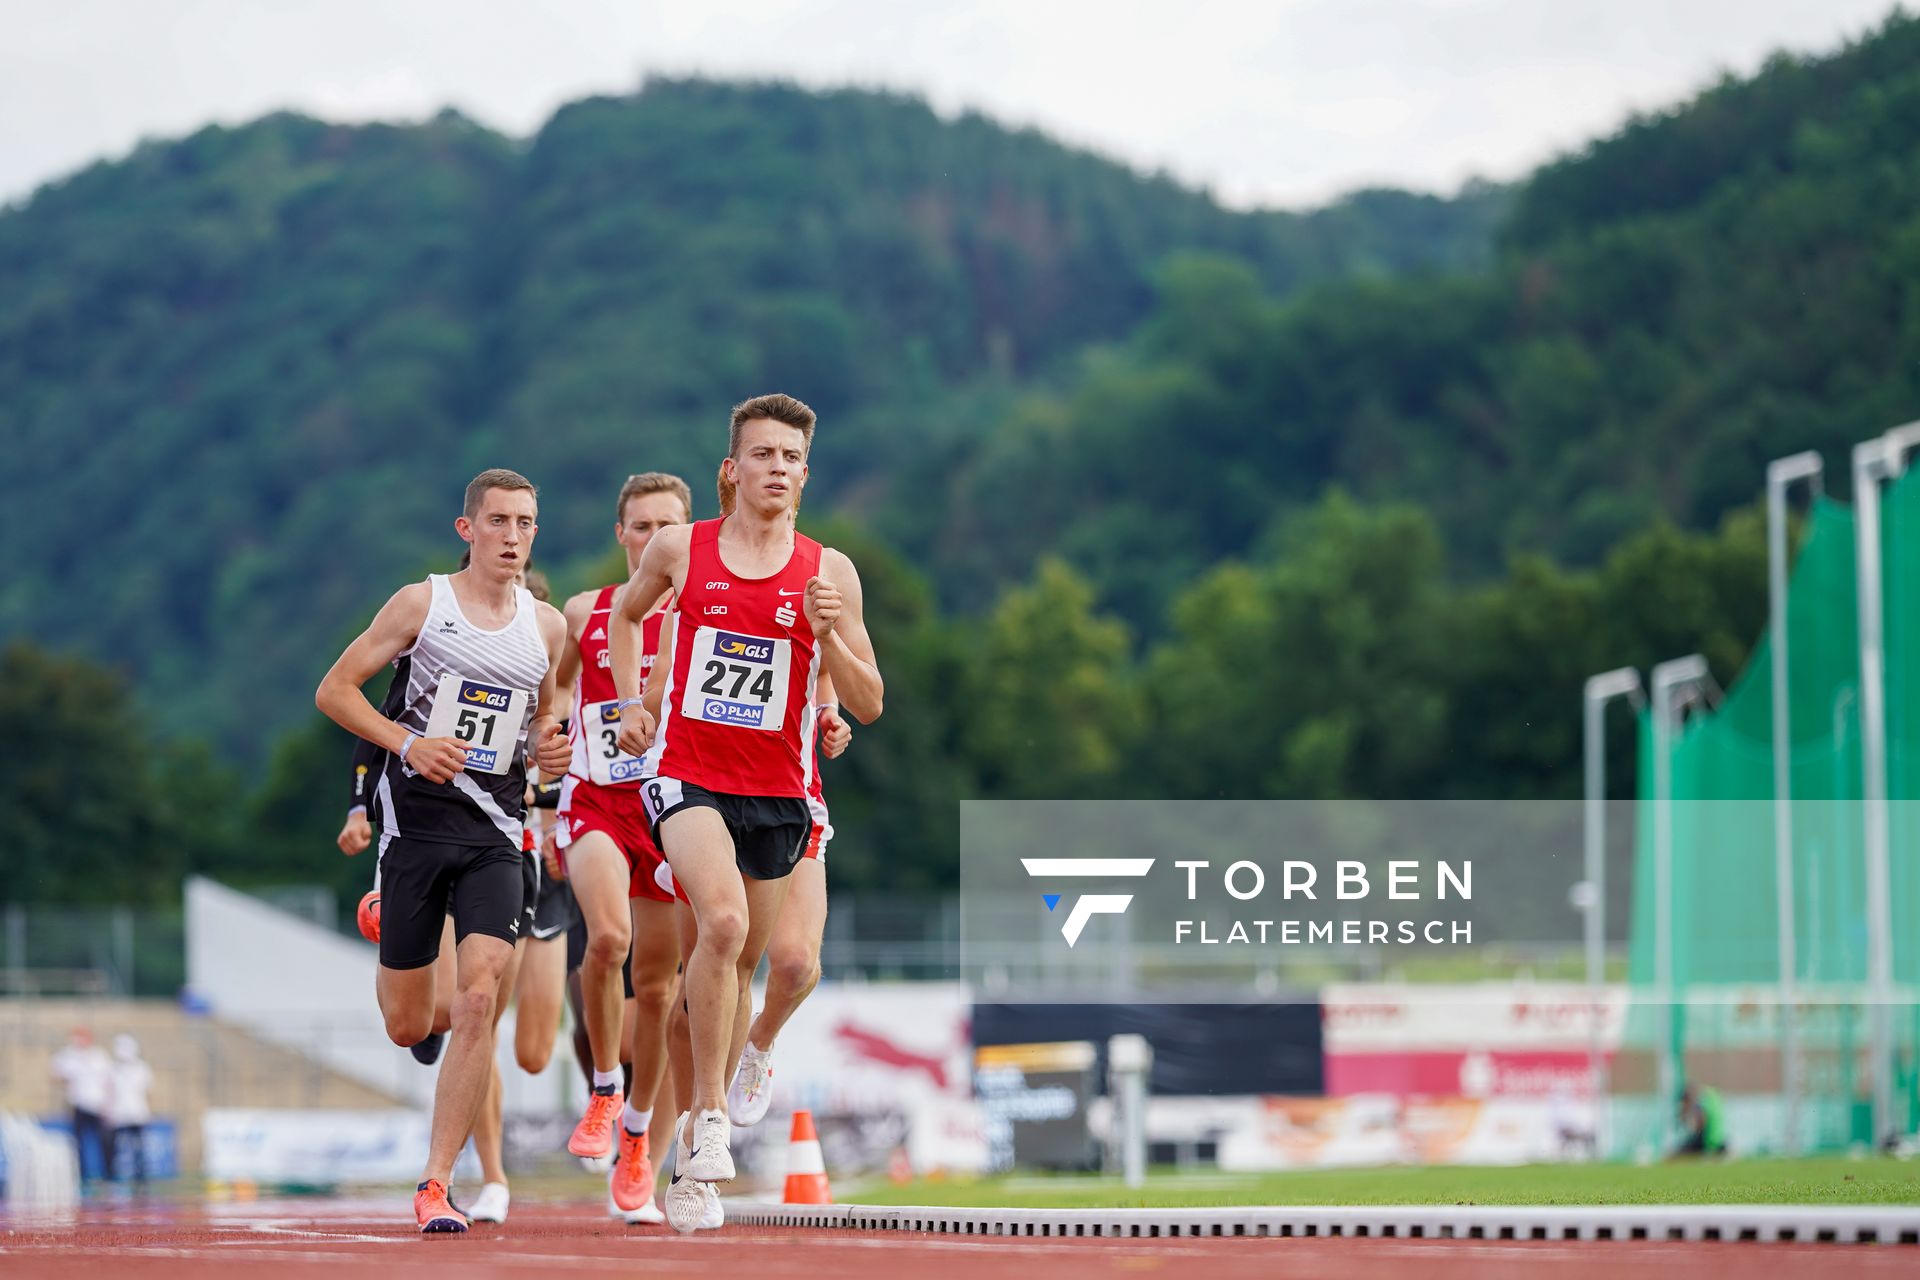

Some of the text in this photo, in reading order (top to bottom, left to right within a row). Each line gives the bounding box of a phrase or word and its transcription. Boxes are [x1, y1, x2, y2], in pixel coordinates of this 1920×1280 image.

[744, 645, 769, 659] GLS
[700, 660, 774, 703] 274
[486, 693, 508, 707] GLS
[728, 705, 762, 719] PLAN
[727, 716, 760, 724] INTERNATIONAL
[455, 709, 496, 747] 51
[466, 751, 495, 764] PLAN
[648, 782, 665, 815] 8
